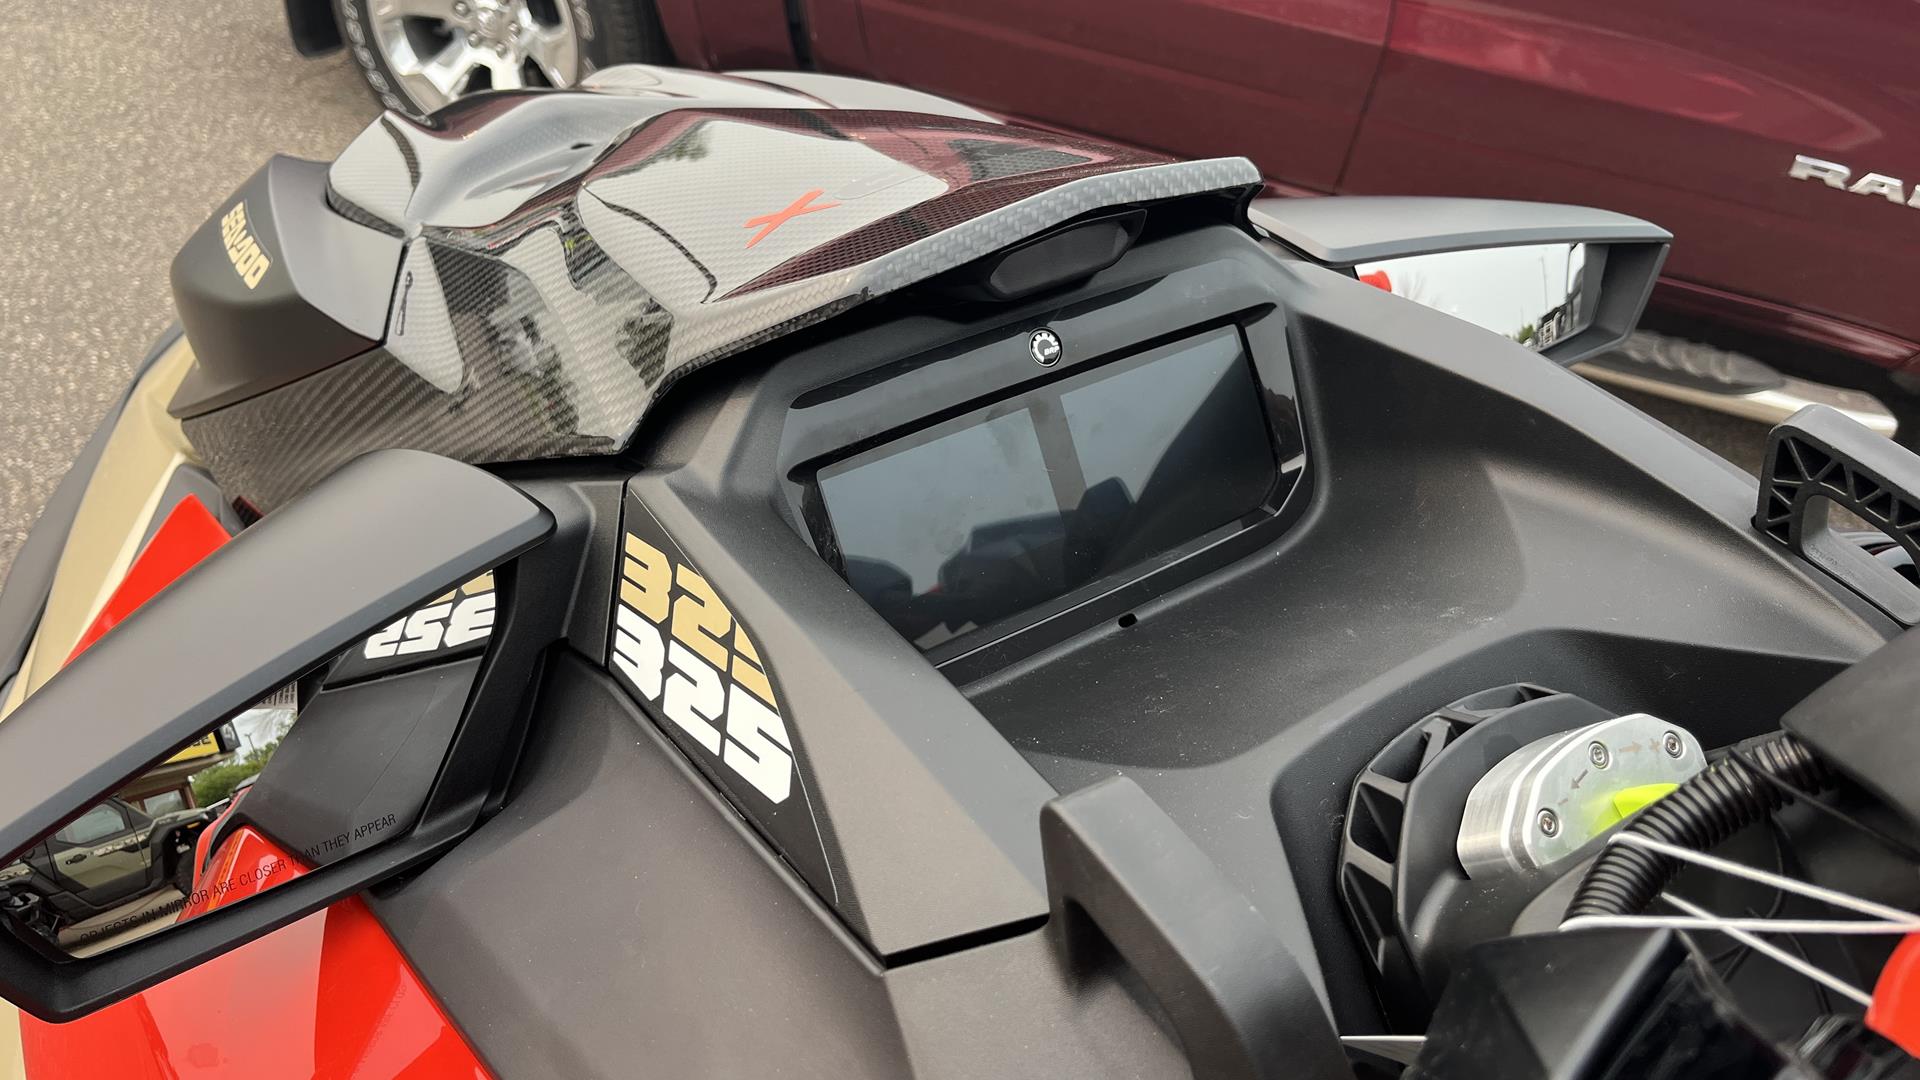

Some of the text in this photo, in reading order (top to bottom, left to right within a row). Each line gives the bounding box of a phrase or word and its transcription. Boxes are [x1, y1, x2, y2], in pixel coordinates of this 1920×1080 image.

[1788, 153, 1920, 209] RA
[620, 531, 778, 711] 32
[613, 603, 793, 804] 325
[142, 909, 157, 924] IN
[158, 889, 209, 918] MIRROR
[212, 878, 237, 898] ARE
[239, 858, 287, 885] CLOSER
[322, 831, 351, 853] THEY
[354, 813, 397, 840] APPEAR
